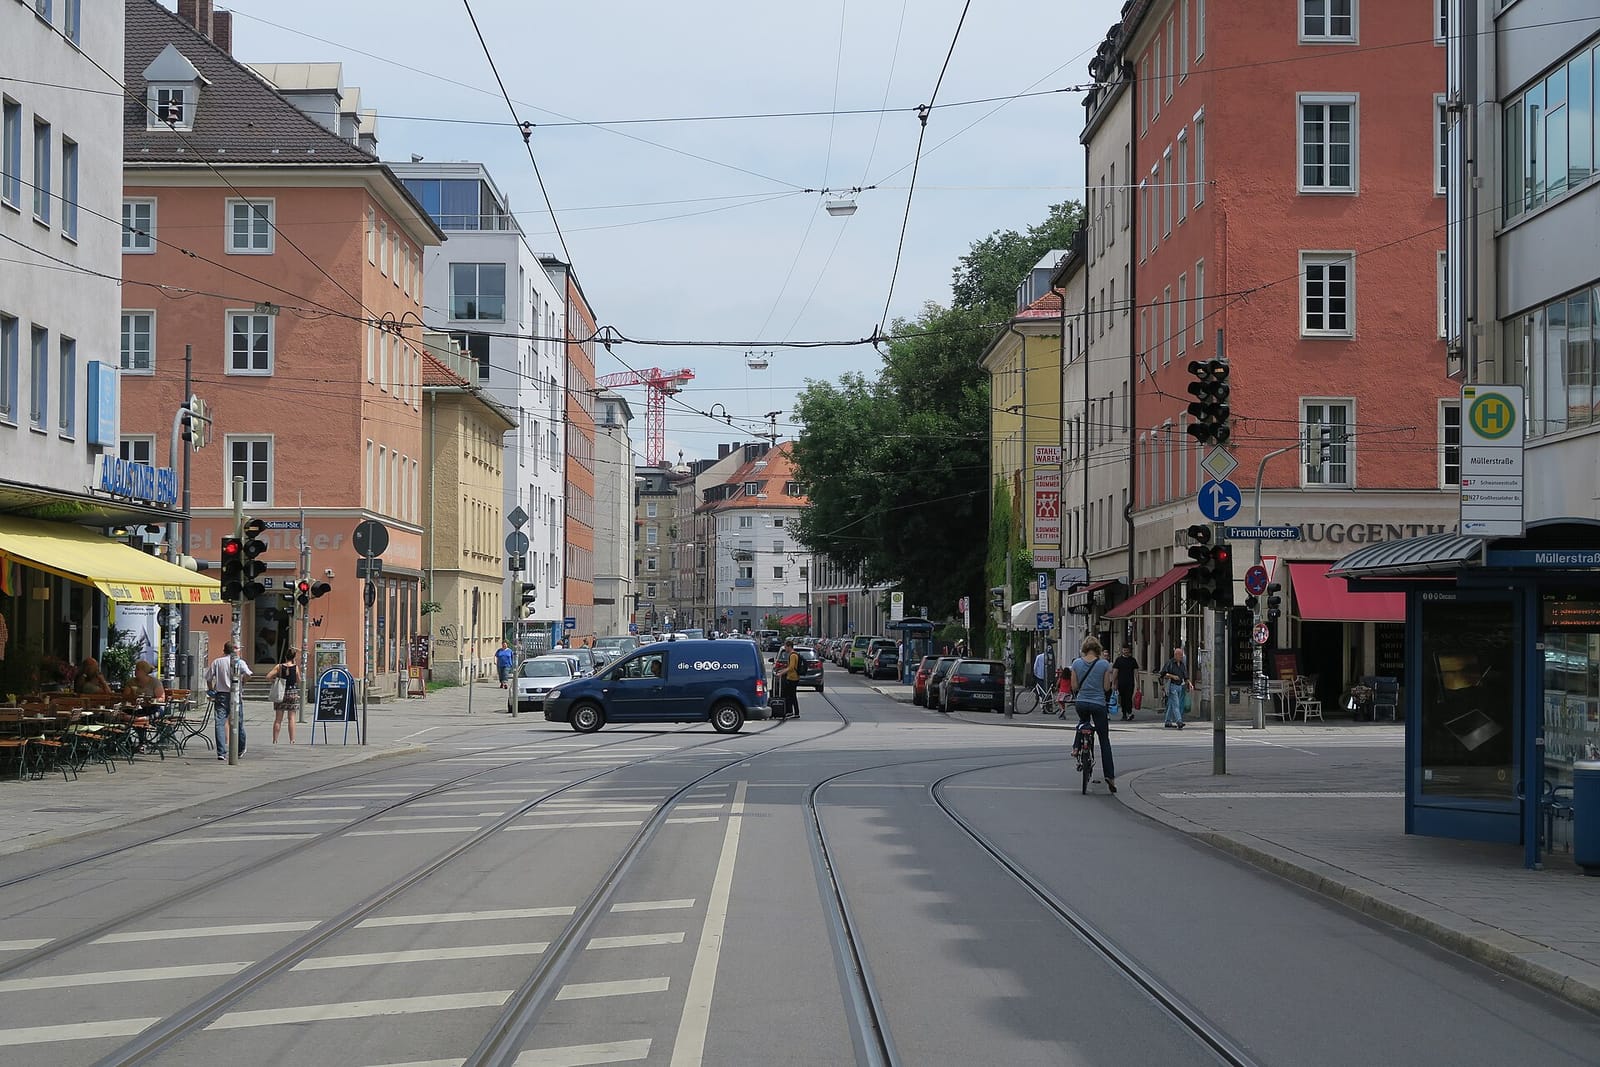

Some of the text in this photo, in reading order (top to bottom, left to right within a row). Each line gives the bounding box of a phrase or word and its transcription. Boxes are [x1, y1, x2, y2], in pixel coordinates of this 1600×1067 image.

[1036, 447, 1060, 455] STAHL-
[1035, 455, 1060, 463] WAREN
[1470, 457, 1514, 465] Müllerstraße
[101, 454, 177, 505] AUGUSTINER BRÄU
[1230, 528, 1296, 539] Fraunhoferstr.
